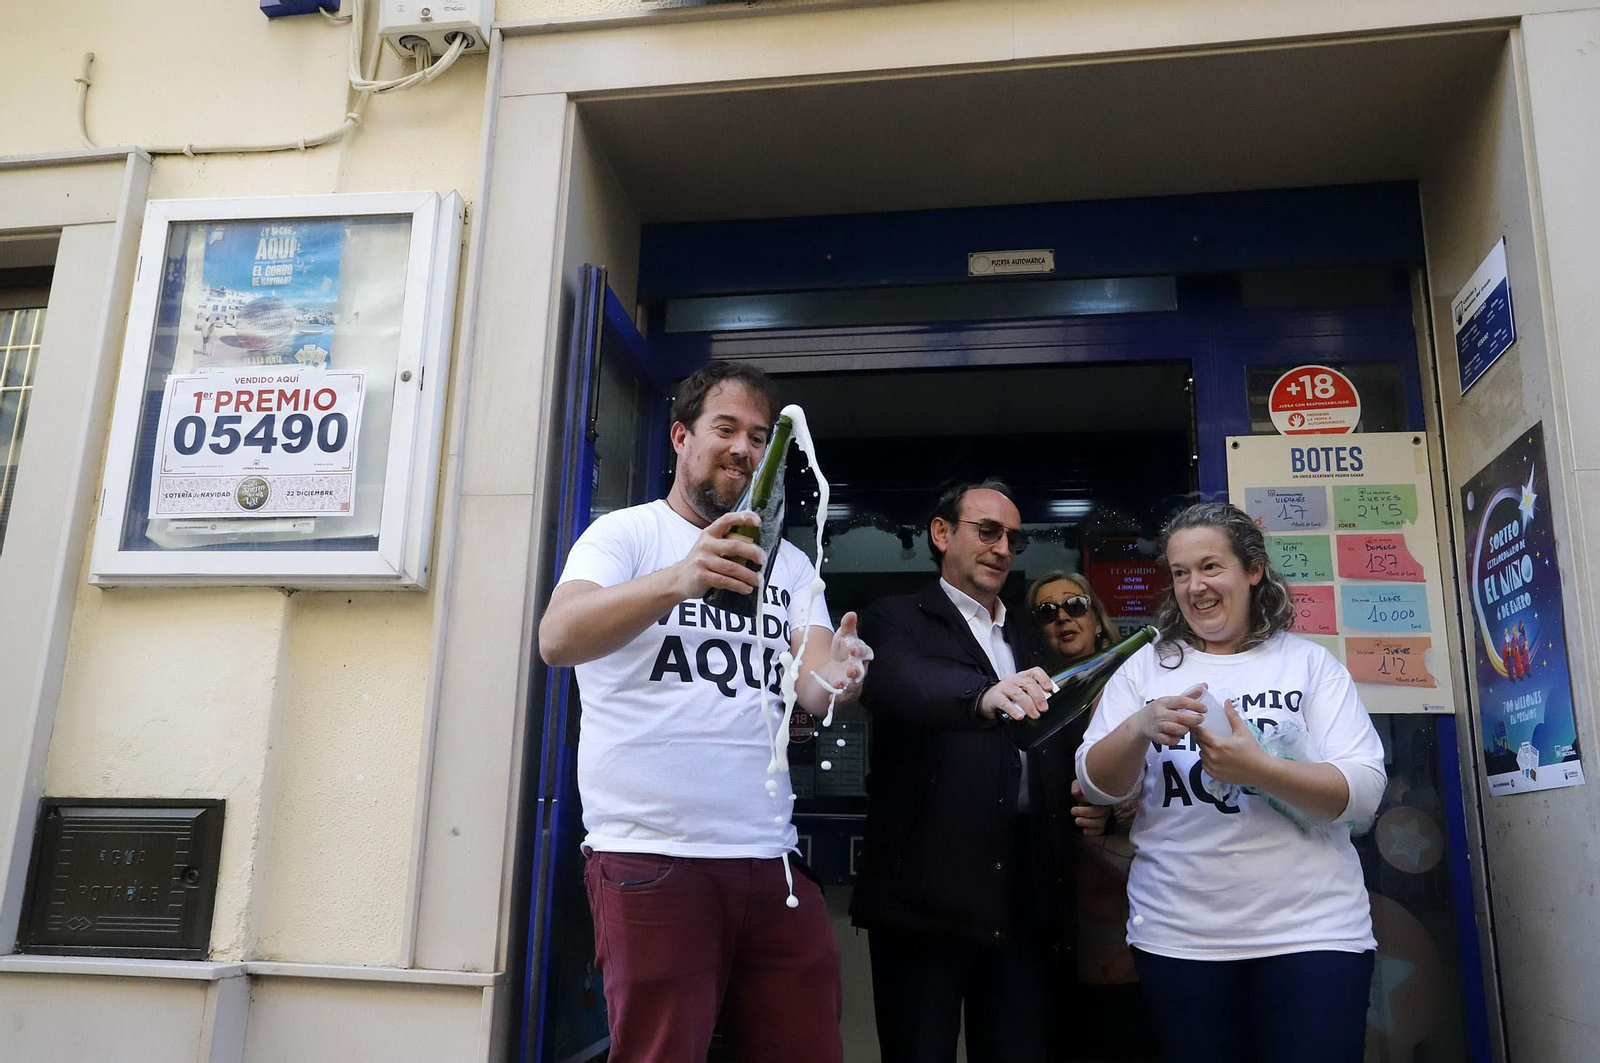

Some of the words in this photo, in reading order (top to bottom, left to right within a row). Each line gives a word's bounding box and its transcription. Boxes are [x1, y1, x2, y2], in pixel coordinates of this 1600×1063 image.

[255, 231, 297, 260] AQUÍ
[252, 265, 263, 276] EL
[265, 264, 293, 276] GORDO
[234, 376, 274, 385] VENDIDO
[276, 375, 300, 383] AQUÍ
[1286, 374, 1335, 400] +18
[214, 387, 337, 414] PREMIO
[173, 412, 349, 456] 05490
[1291, 446, 1363, 473] BOTES
[1277, 504, 1308, 520] 17
[1489, 520, 1519, 554] SORTEO
[1486, 546, 1519, 571] EXTRAORDINARIO
[1519, 539, 1526, 550] DE
[1123, 567, 1156, 575] GORDO
[1483, 574, 1500, 605] EL
[1499, 554, 1533, 597] NIÑO
[1497, 606, 1502, 621] 6
[1501, 604, 1510, 619] DE
[1510, 592, 1531, 614] ENERO
[1502, 699, 1513, 714] 700
[1514, 690, 1542, 710] MILLONES
[1510, 714, 1517, 725] EN
[1517, 708, 1537, 724] PREMIOS
[99, 848, 146, 865] AGUA
[77, 885, 159, 902] POTABLE
